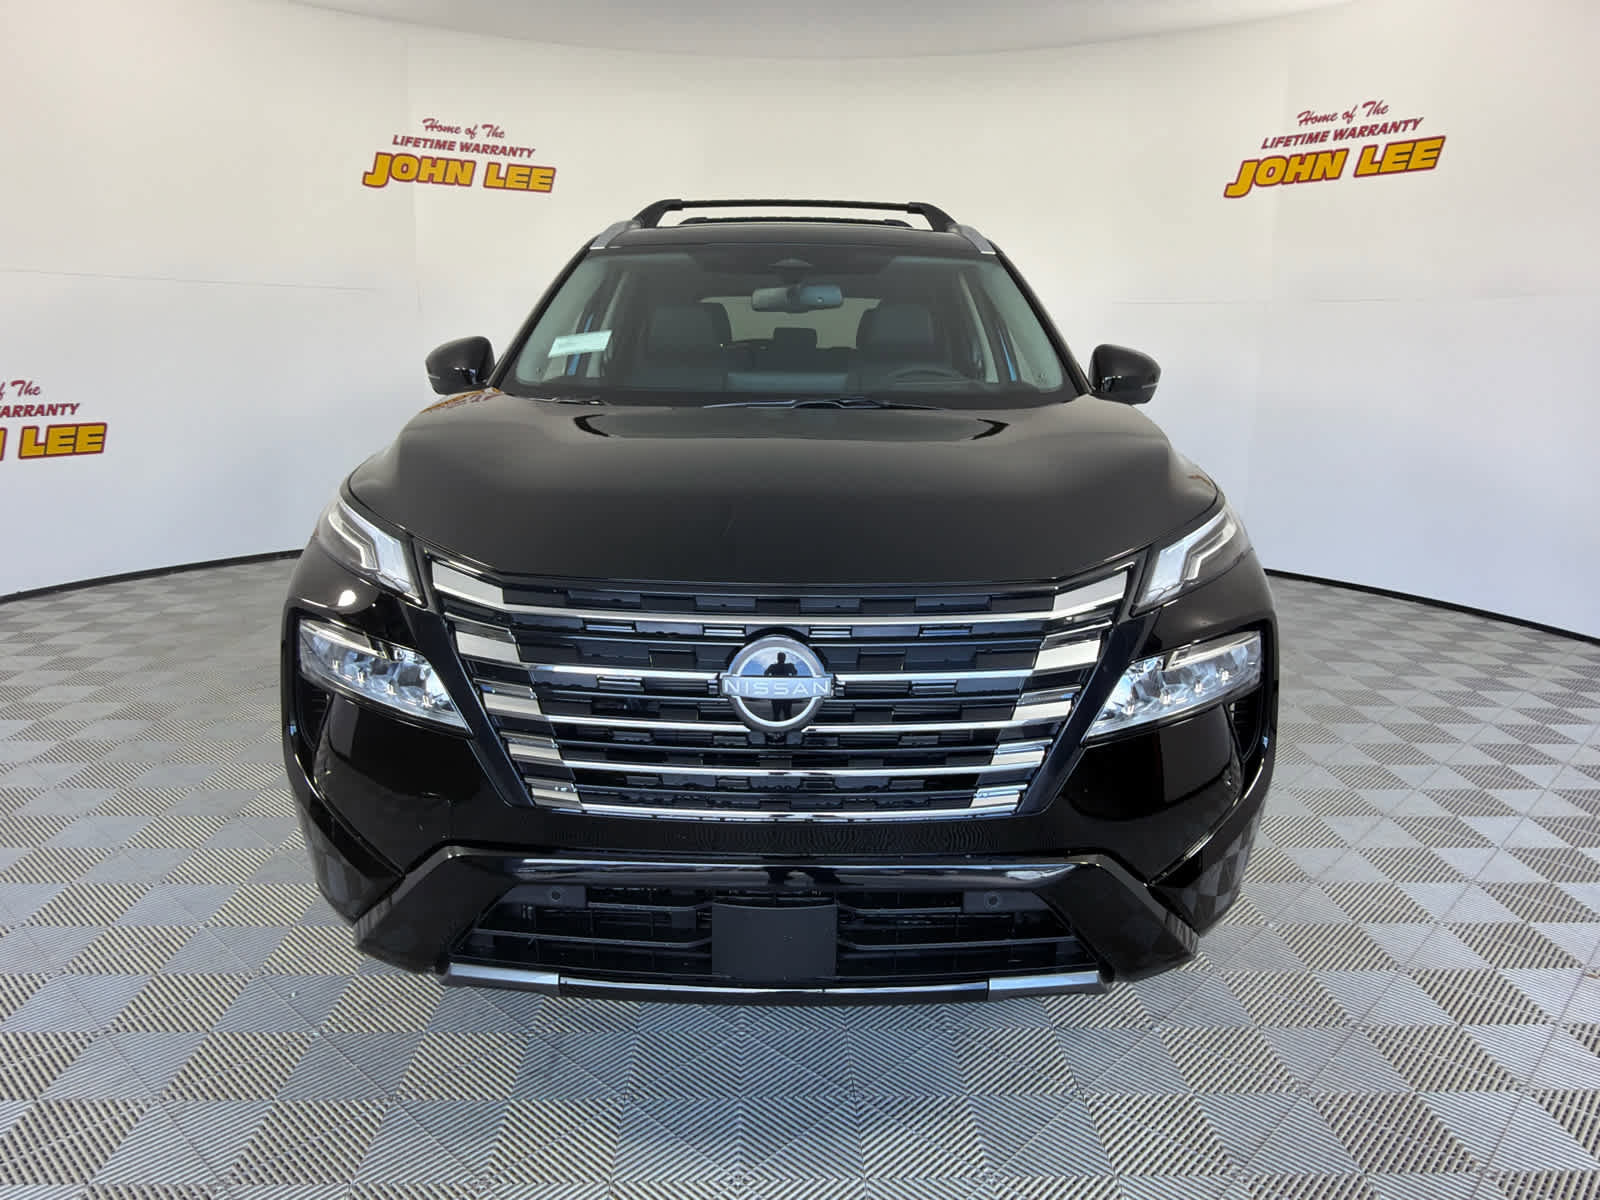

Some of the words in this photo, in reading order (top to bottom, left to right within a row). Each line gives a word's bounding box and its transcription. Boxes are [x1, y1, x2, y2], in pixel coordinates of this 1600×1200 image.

[1297, 110, 1338, 127] Home
[1341, 105, 1358, 125] of
[1362, 99, 1389, 118] The
[422, 118, 461, 135] Home
[465, 125, 478, 139] of
[481, 124, 505, 139] The
[1261, 130, 1330, 150] LIFETIME
[1332, 117, 1424, 141] WARRANTY
[392, 134, 457, 151] LIFETIME
[459, 141, 536, 158] WARRANTY
[362, 152, 476, 188] JOHN
[483, 162, 556, 193] LEE
[1223, 147, 1350, 198] JOHN
[1353, 135, 1446, 178] LEE
[10, 379, 41, 397] The
[0, 402, 80, 418] ARRANTY
[18, 422, 107, 460] LEE
[724, 679, 829, 696] NISSAN
